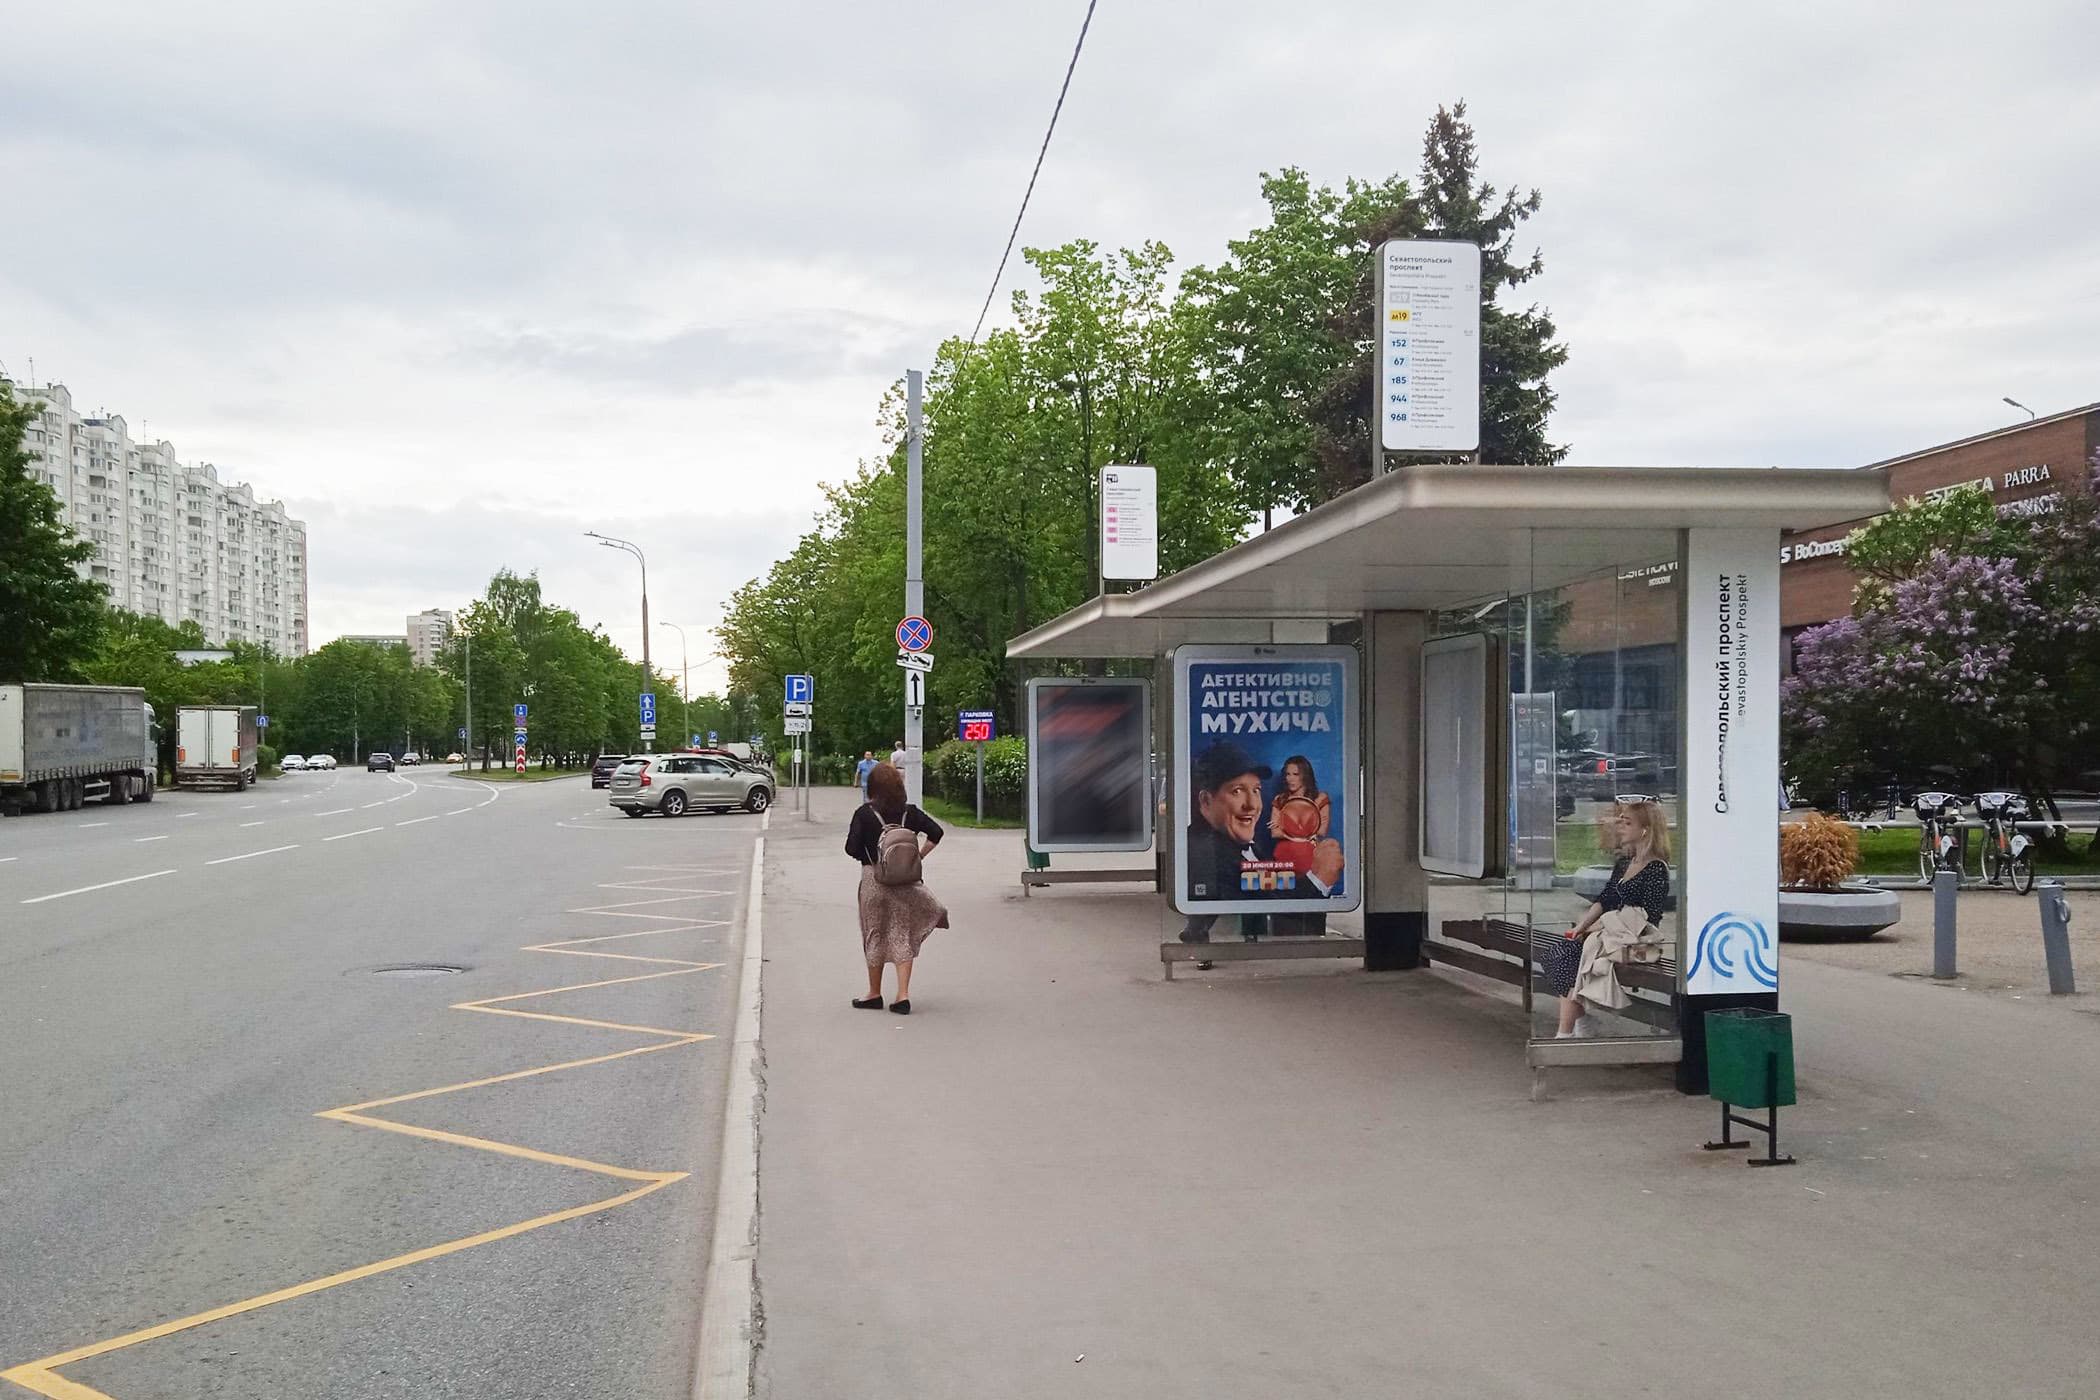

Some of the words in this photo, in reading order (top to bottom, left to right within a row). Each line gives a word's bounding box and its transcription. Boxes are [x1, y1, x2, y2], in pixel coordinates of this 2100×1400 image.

[1393, 358, 1405, 366] 67
[1390, 394, 1407, 402] 944
[1390, 413, 1407, 421] 968
[2004, 464, 2050, 488] PARRA
[1735, 574, 1749, 629] Prospekt
[1719, 574, 1733, 655] проспект
[793, 679, 806, 699] P
[1201, 672, 1332, 688] ДЕТЕКТИВНОЕ
[1735, 632, 1749, 727] evastopolskiy
[1201, 689, 1332, 708] АГЕНТСТВО
[644, 710, 653, 722] P
[1201, 711, 1331, 734] МУХИЧА
[964, 723, 990, 740] 250
[1240, 870, 1296, 891] ТНТ
